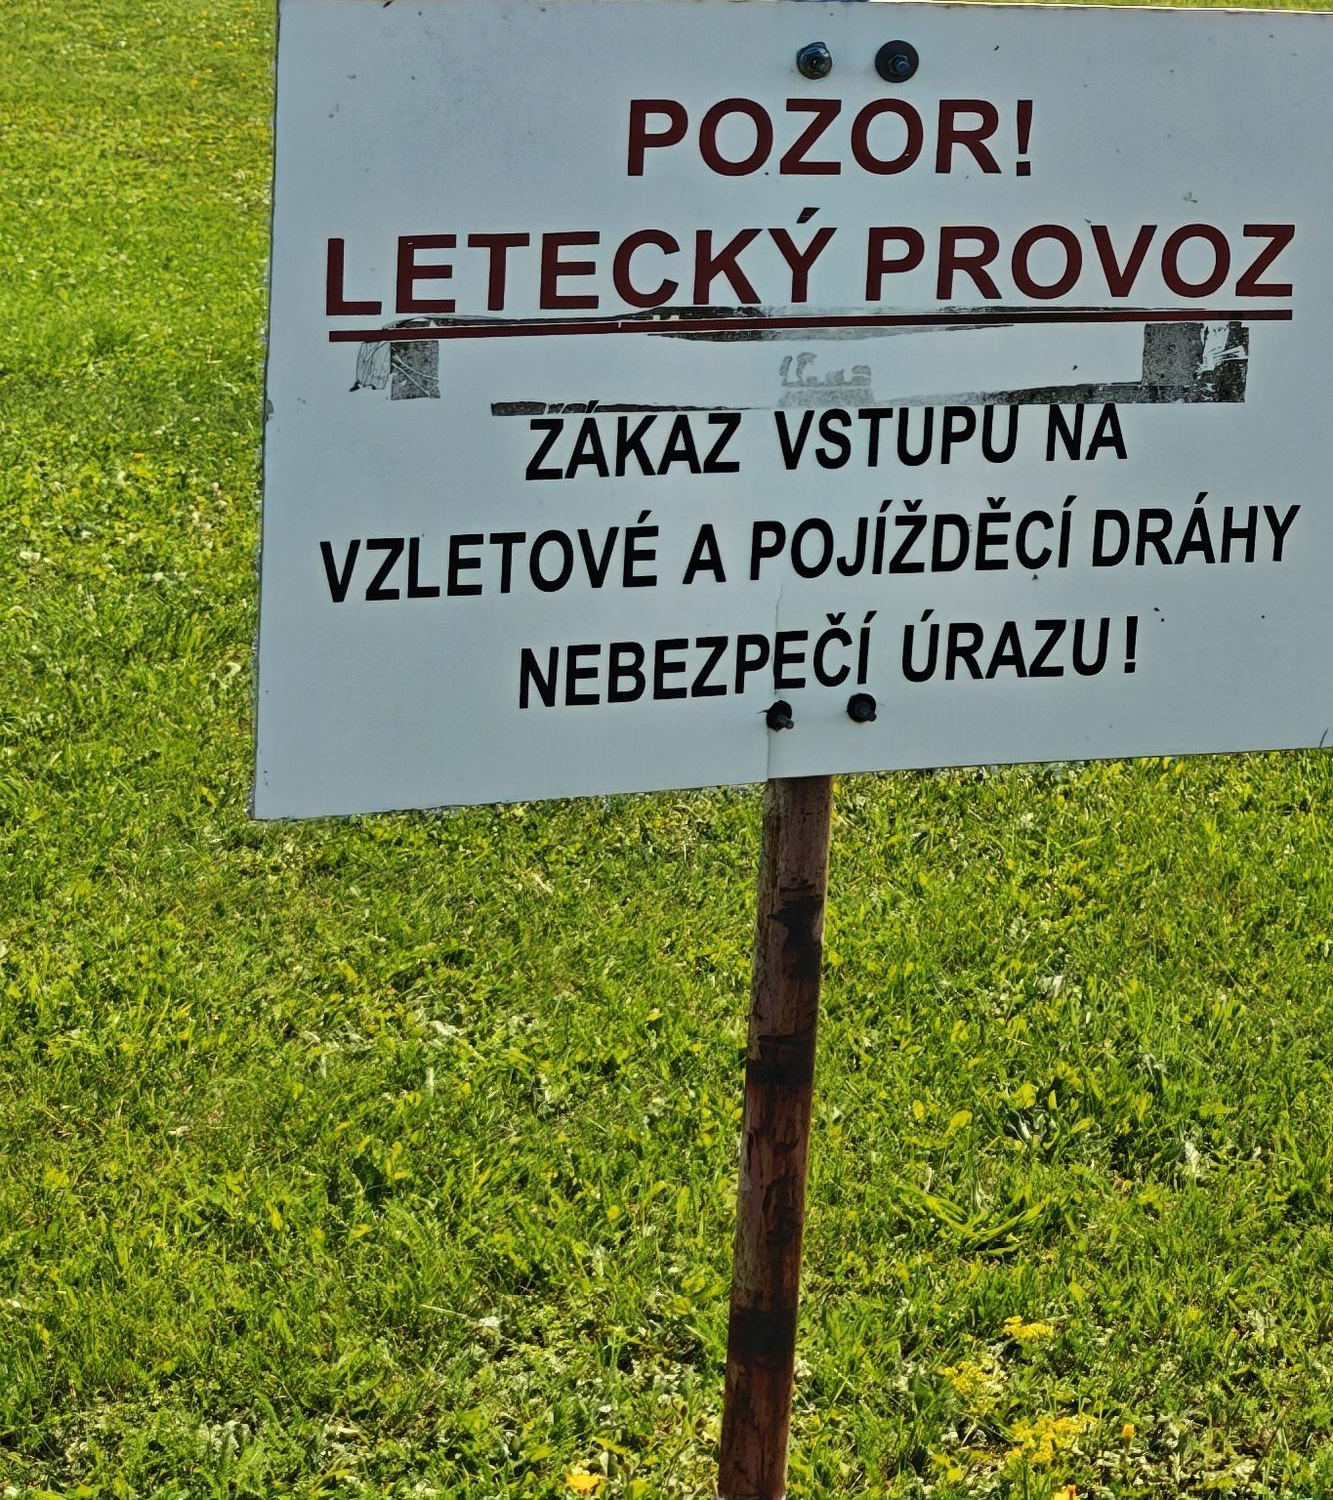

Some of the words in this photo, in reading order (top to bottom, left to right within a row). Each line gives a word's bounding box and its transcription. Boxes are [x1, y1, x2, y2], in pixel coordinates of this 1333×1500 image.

[628, 97, 1034, 177] POZOR!
[326, 207, 838, 316] LETECKÝ
[865, 223, 1296, 301] PROVOZ
[525, 399, 742, 481] ZÁKAZ
[774, 404, 1019, 471] VSTUPU
[1046, 402, 1128, 462] NA
[320, 509, 661, 604] VZLETOVÉ
[682, 524, 727, 585] A
[750, 496, 1078, 581] POJÍŽDĚCÍ
[1092, 491, 1302, 568] DRÁHY
[519, 609, 878, 710] NEBEZPEČÍ
[902, 608, 1139, 683] ÚRAZU!
